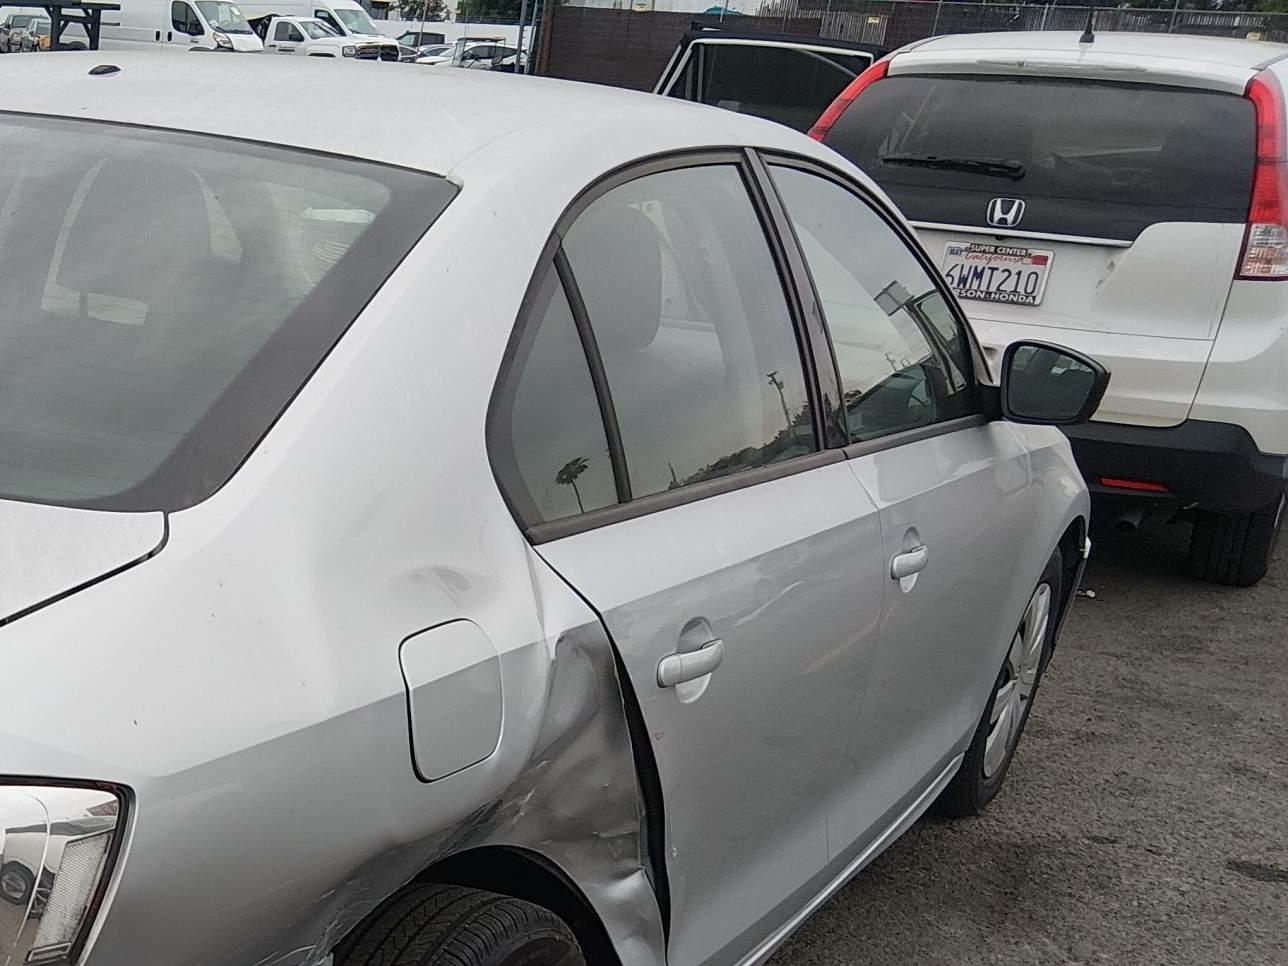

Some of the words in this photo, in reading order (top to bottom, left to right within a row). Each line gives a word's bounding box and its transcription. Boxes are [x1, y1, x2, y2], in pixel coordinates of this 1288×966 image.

[971, 244, 996, 253] SUPER
[997, 247, 1027, 257] CENTER
[945, 264, 1039, 295] 6WMT210
[954, 289, 986, 299] RSON
[990, 292, 1035, 304] HONDA
